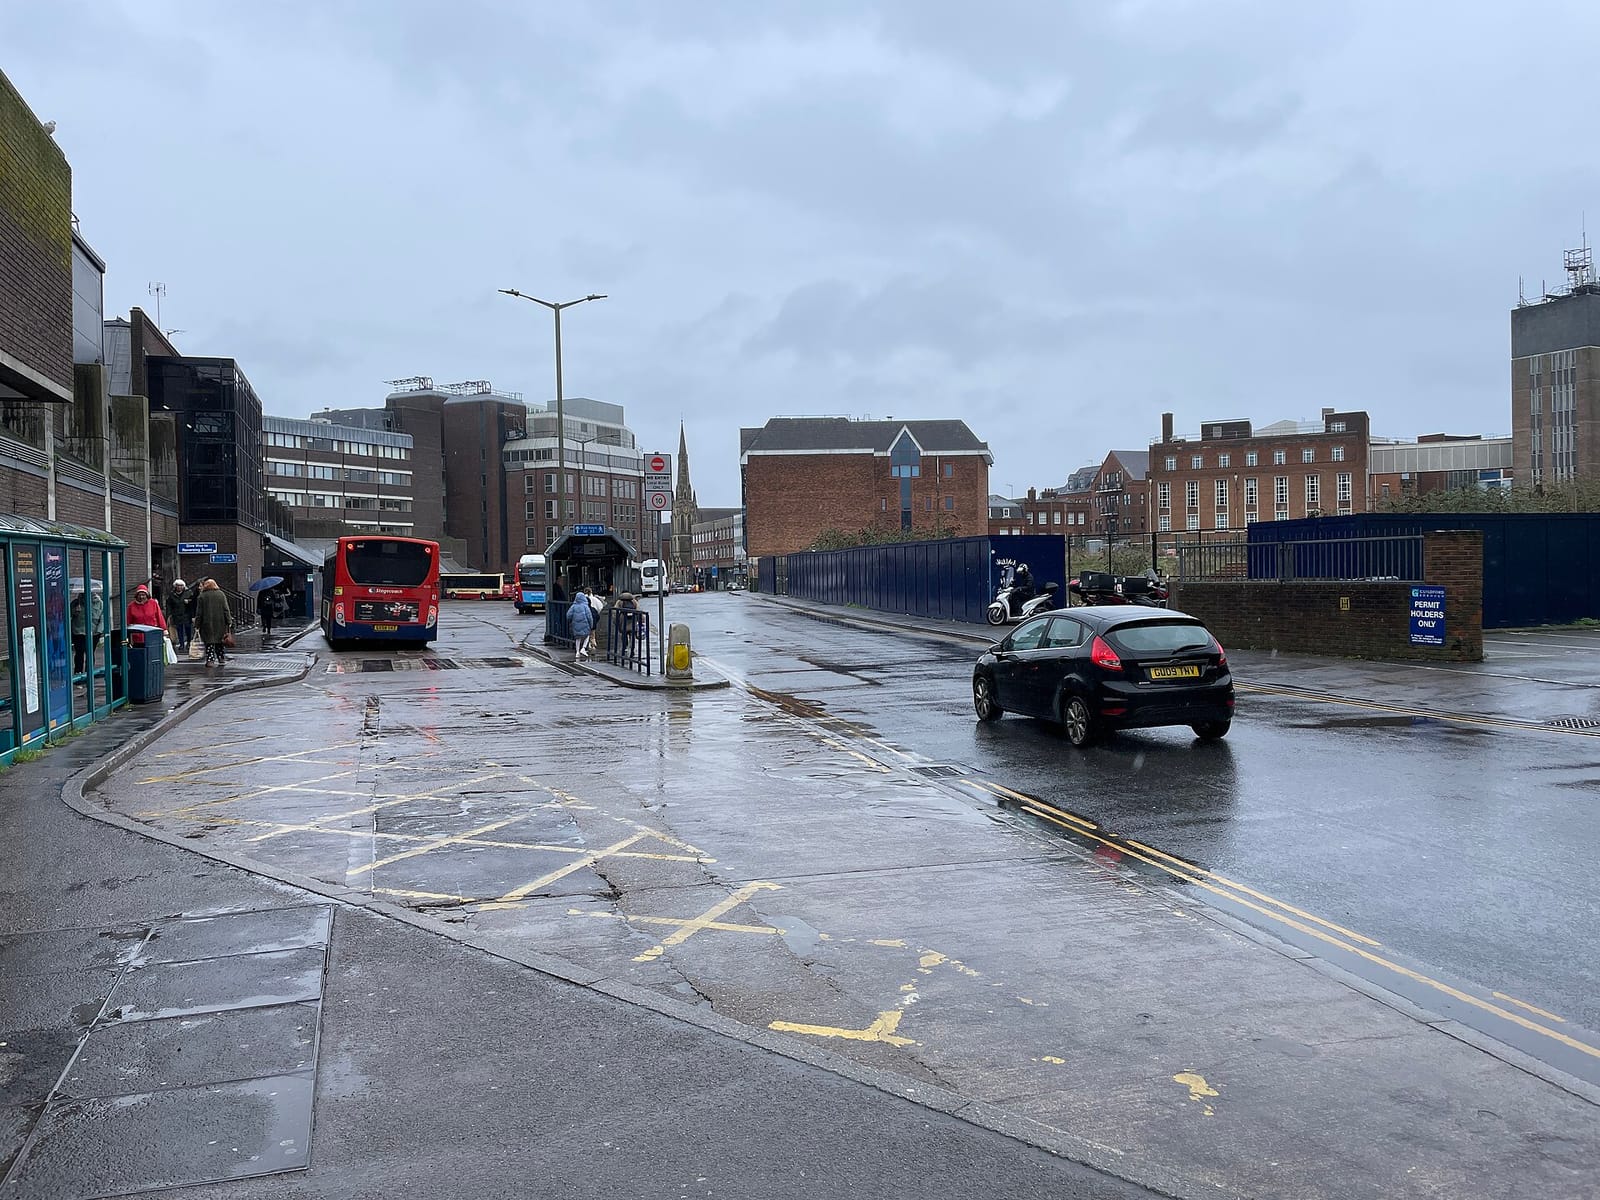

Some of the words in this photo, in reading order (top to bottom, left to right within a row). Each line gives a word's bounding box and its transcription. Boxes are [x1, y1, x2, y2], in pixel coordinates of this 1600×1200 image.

[1414, 601, 1440, 609] PERMIT
[1410, 610, 1445, 619] HOLDERS
[1418, 620, 1436, 628] ONLY
